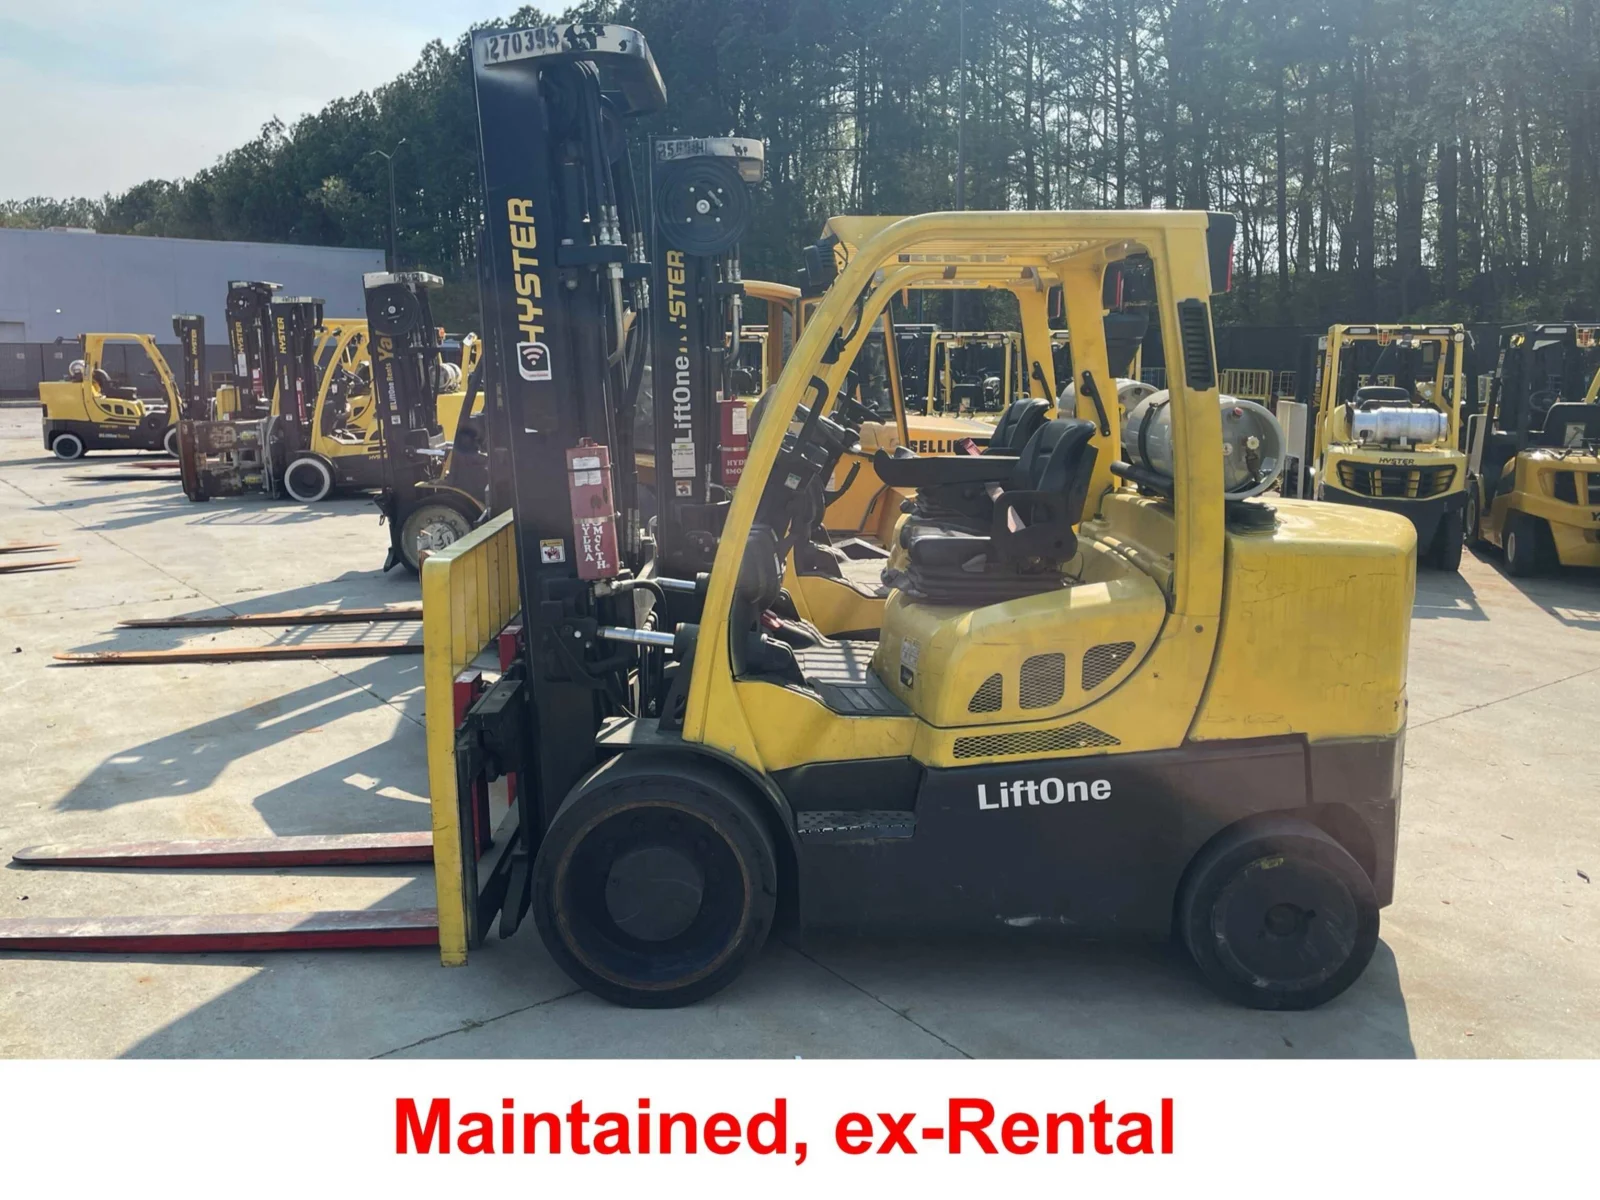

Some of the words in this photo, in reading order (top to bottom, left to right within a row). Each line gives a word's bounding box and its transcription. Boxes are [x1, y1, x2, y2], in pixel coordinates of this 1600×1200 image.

[508, 198, 545, 344] HYSTER
[276, 316, 287, 355] HYSTER
[672, 355, 693, 443] LiftOne
[726, 459, 745, 467] HYD
[910, 440, 958, 453] SELLI
[978, 778, 1111, 809] LiftOne
